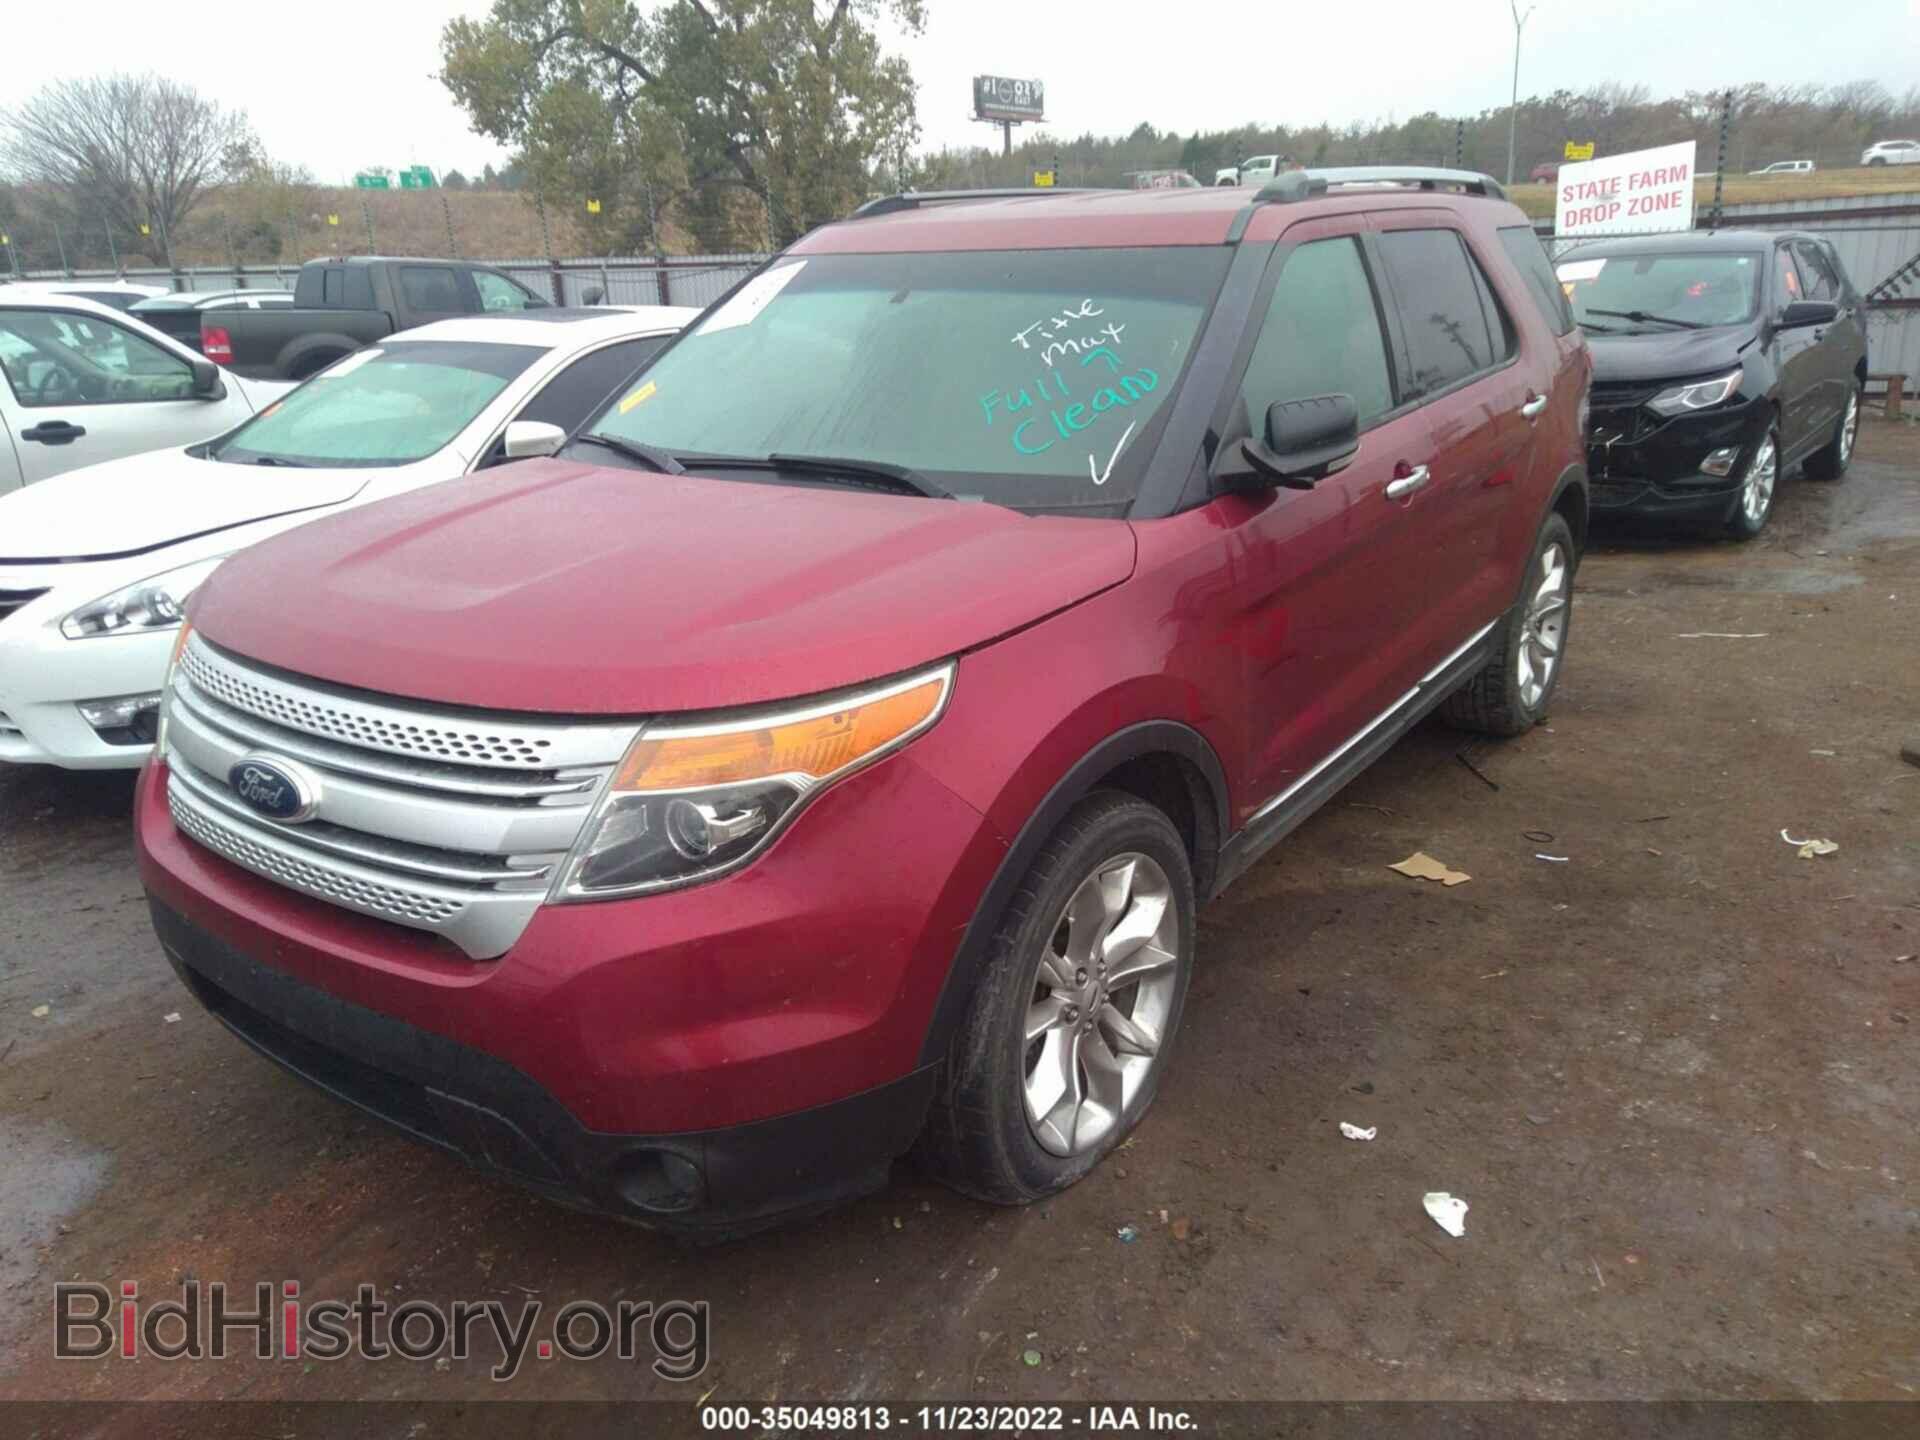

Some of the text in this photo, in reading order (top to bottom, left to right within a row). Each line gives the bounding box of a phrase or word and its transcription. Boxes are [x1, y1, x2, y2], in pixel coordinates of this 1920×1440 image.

[1563, 164, 1688, 203] STATE FARM
[1565, 190, 1682, 228] DROP ZONE
[239, 766, 285, 808] Ford
